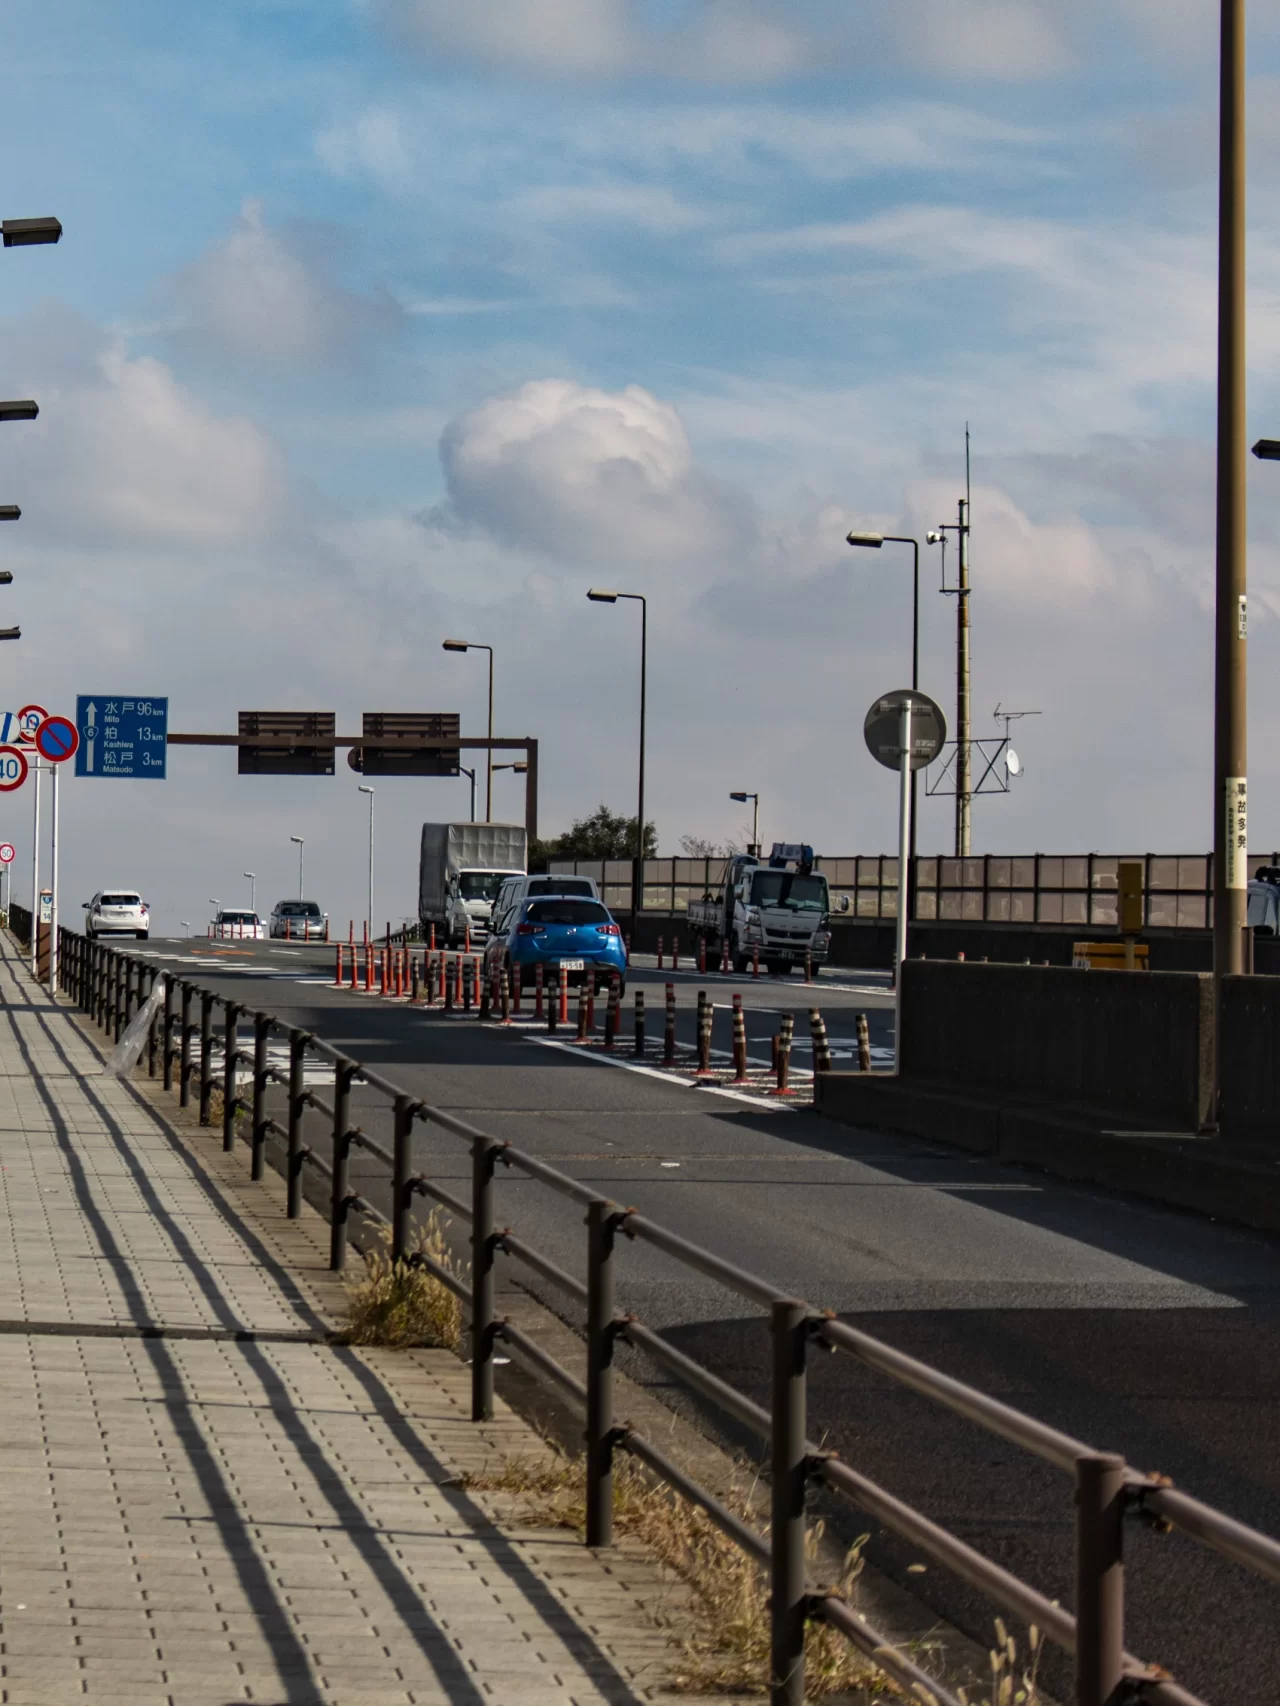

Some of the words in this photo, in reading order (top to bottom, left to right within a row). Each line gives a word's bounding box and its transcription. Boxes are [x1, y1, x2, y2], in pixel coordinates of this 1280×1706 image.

[104, 701, 135, 715] 水戸
[137, 702, 152, 716] 96
[152, 708, 164, 716] km
[104, 715, 120, 723] Mito
[87, 728, 94, 737] 6
[104, 726, 118, 740] 柏
[136, 726, 152, 741] 13
[152, 733, 163, 741] km
[103, 740, 134, 749] Kashiwa
[103, 750, 134, 765] 松戸
[142, 752, 151, 766] 3
[151, 758, 163, 766] km
[103, 765, 134, 774] Matsudo
